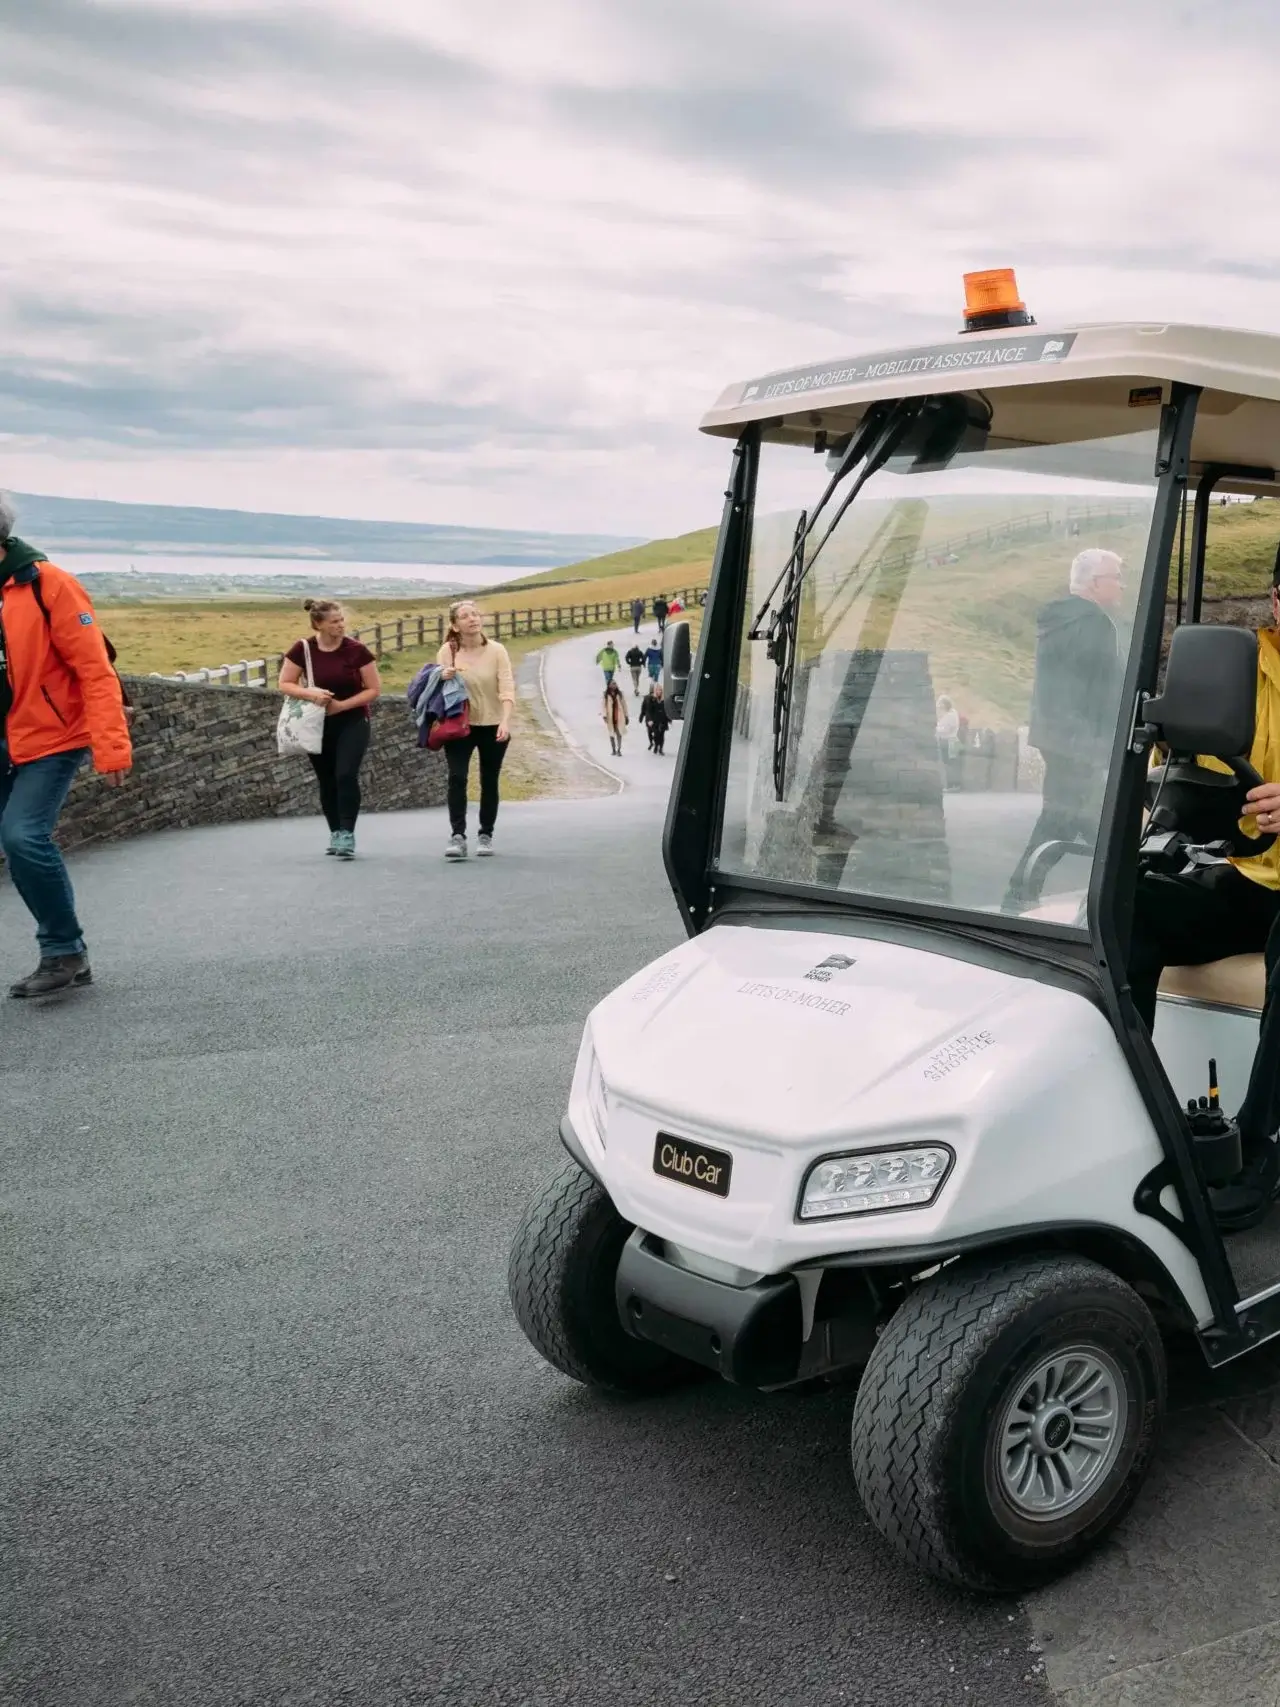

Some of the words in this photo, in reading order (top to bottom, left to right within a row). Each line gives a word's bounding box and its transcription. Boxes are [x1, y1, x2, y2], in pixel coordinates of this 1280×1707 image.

[764, 380, 795, 400] LIFTS
[795, 376, 812, 391] OF
[810, 368, 857, 388] MOHER
[864, 357, 934, 378] MOBILITY
[931, 347, 1027, 369] ASSISTANCE
[737, 982, 778, 998] LIFTS
[774, 989, 799, 1001] OF
[793, 993, 852, 1016] MOHER
[923, 1030, 991, 1078] ATLANTIC
[930, 1036, 967, 1060] WILD
[931, 1038, 996, 1081] SHUTTLE
[661, 1144, 693, 1175] Club
[694, 1155, 722, 1184] Car
